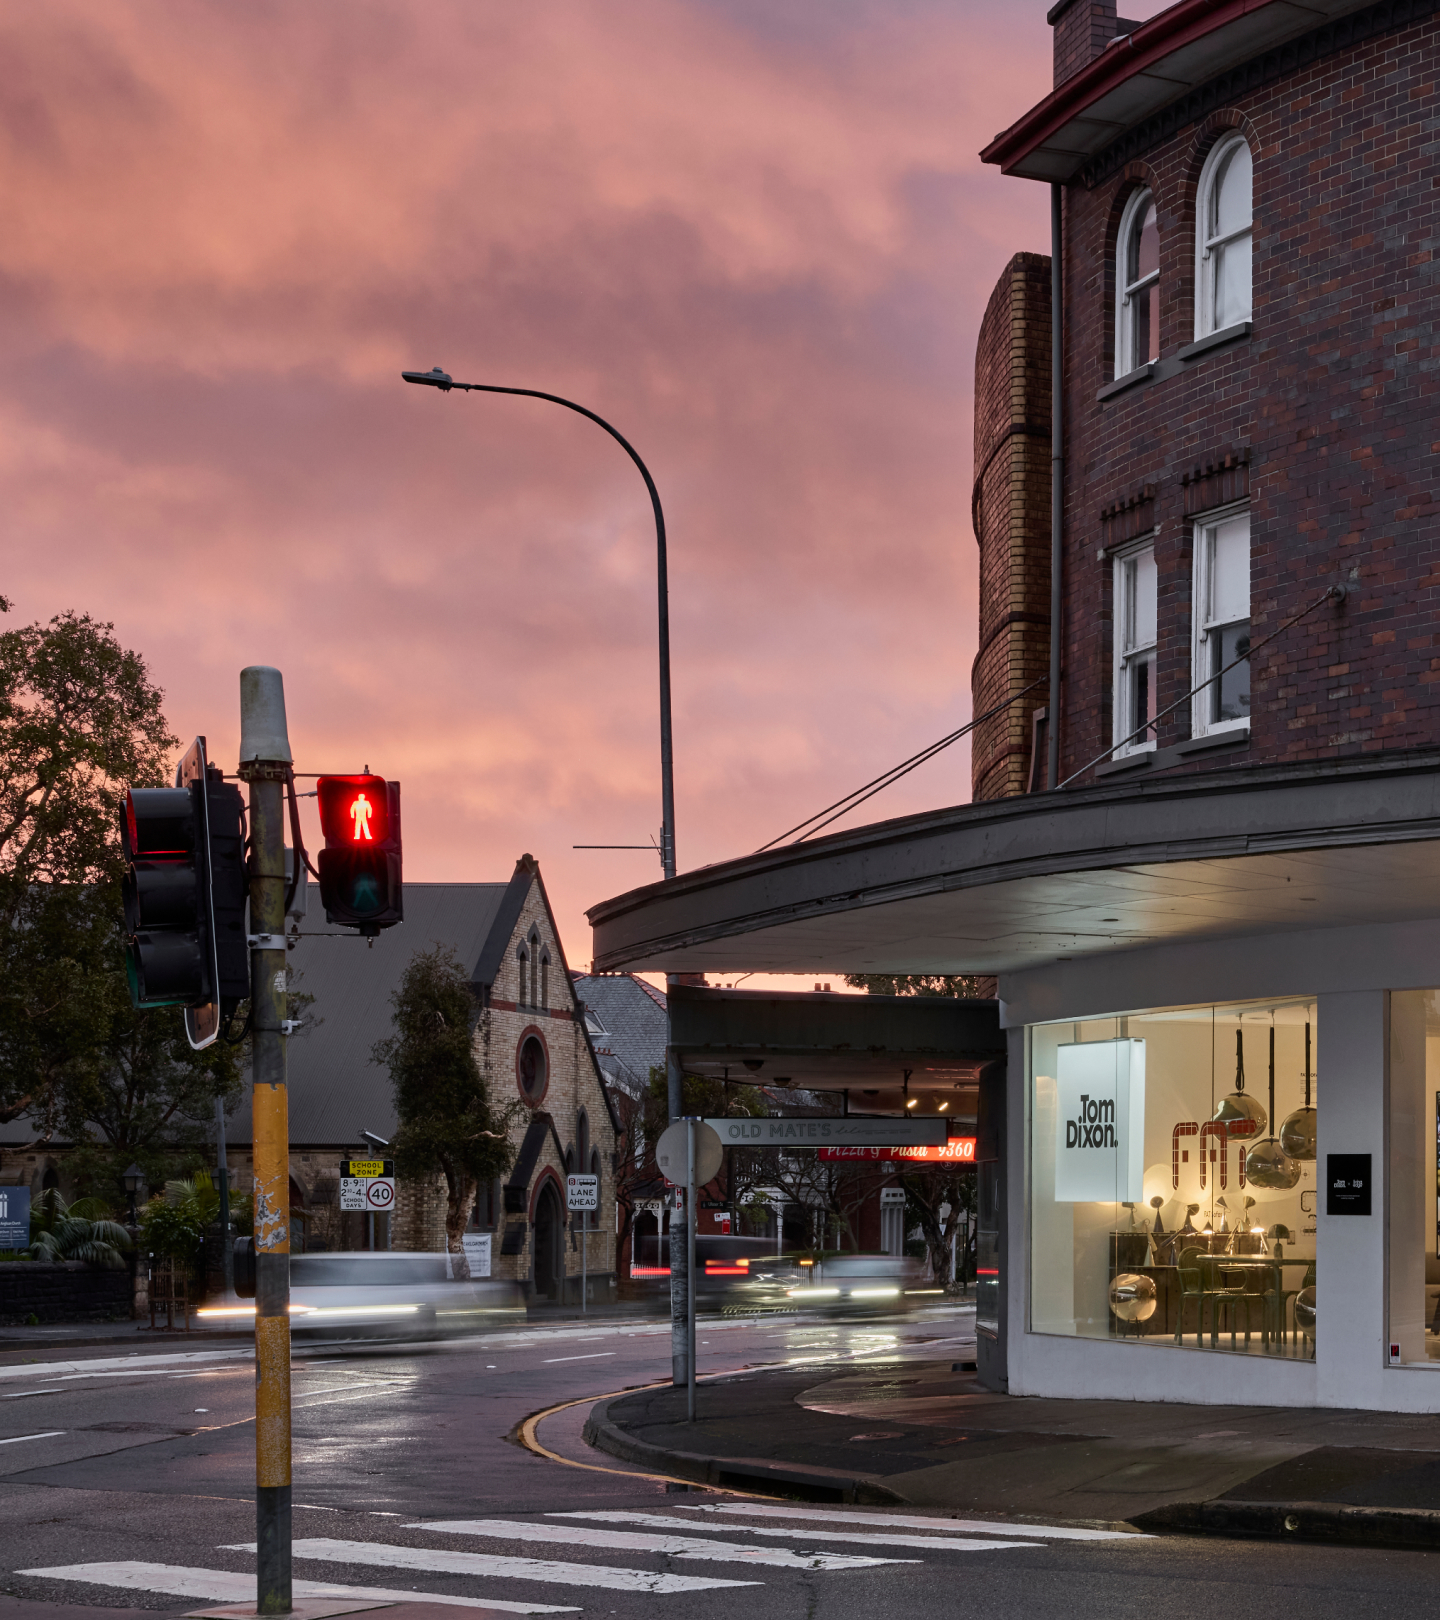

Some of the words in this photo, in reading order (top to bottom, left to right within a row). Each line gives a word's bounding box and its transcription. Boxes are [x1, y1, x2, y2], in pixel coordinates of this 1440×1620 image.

[1080, 1094, 1115, 1124] Tom
[728, 1124, 762, 1139] OLD
[769, 1122, 832, 1138] MATE'S
[1066, 1115, 1119, 1149] Dixon.
[938, 1143, 973, 1157] 9360
[372, 1189, 390, 1200] 40
